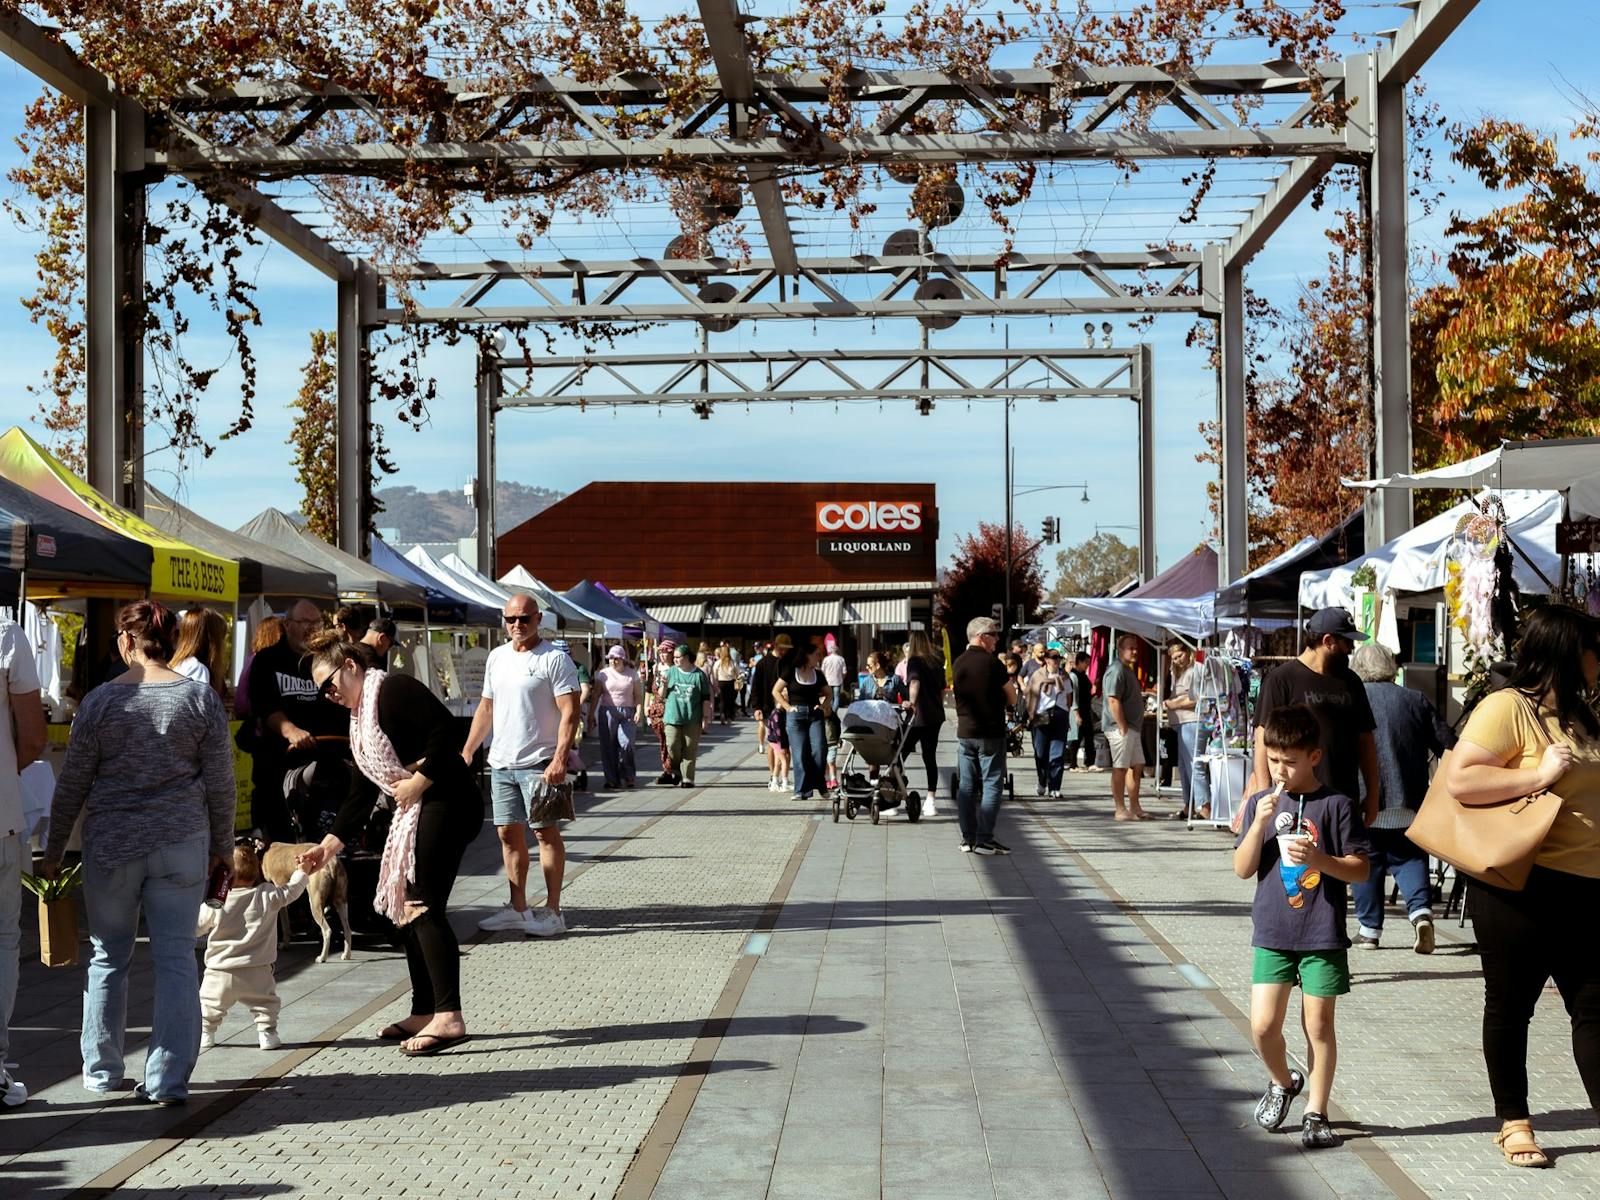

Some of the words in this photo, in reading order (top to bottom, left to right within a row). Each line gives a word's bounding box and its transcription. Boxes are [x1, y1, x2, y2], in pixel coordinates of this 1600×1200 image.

[819, 501, 921, 530] coles
[830, 542, 911, 553] LIQUORLAND
[170, 556, 191, 588] THE
[193, 562, 199, 591] 3
[201, 561, 225, 594] BEES
